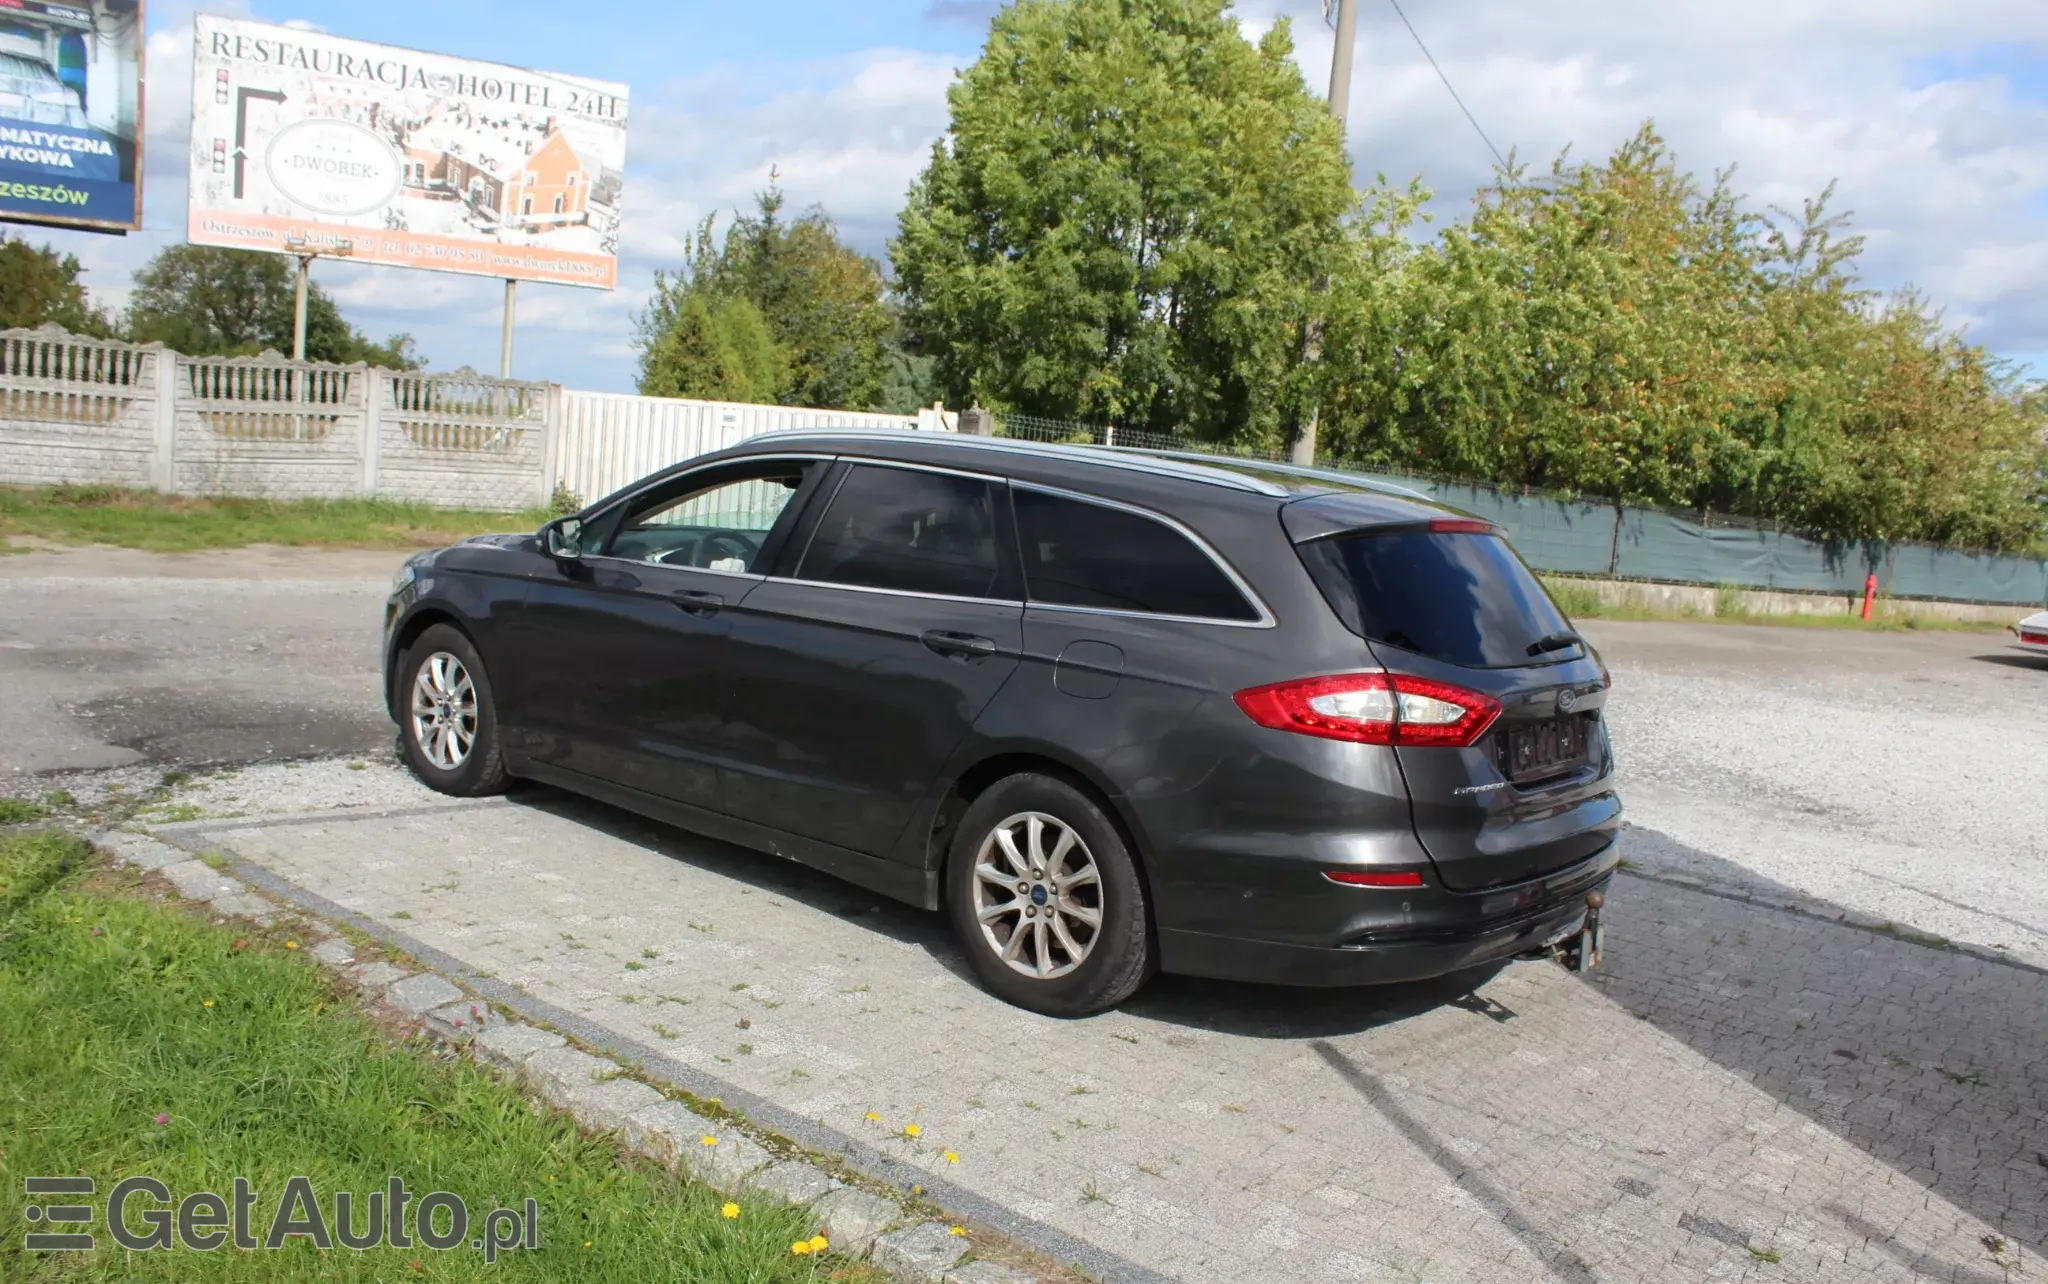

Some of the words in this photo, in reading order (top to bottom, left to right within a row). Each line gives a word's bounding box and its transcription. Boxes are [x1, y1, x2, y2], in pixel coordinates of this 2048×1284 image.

[211, 31, 428, 90] RESTAURACJA
[456, 73, 556, 108] HOTEL
[566, 91, 617, 118] 24H
[293, 154, 372, 178] DWOREK
